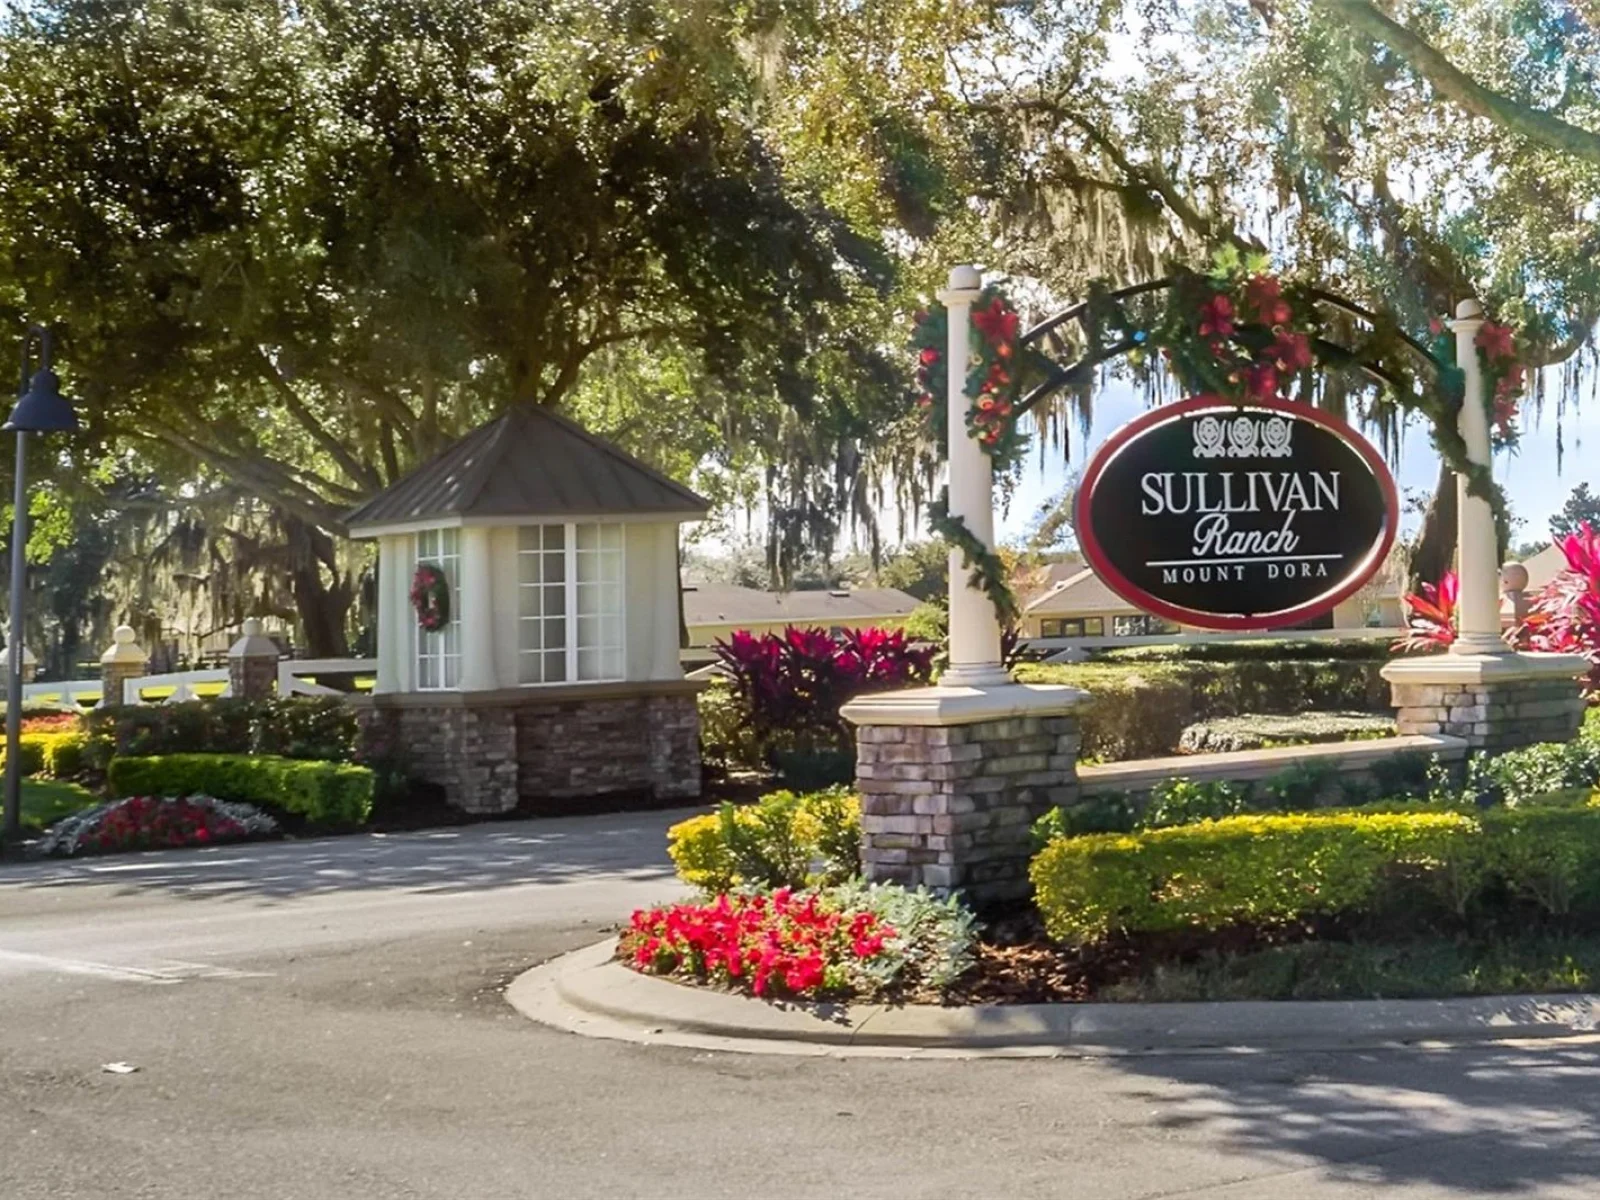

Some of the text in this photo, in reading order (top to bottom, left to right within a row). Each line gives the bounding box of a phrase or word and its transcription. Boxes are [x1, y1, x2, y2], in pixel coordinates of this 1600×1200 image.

[1141, 472, 1340, 515] SULLIVAN
[1192, 510, 1299, 556] Ranch
[1163, 563, 1327, 583] MOUNT DORA
